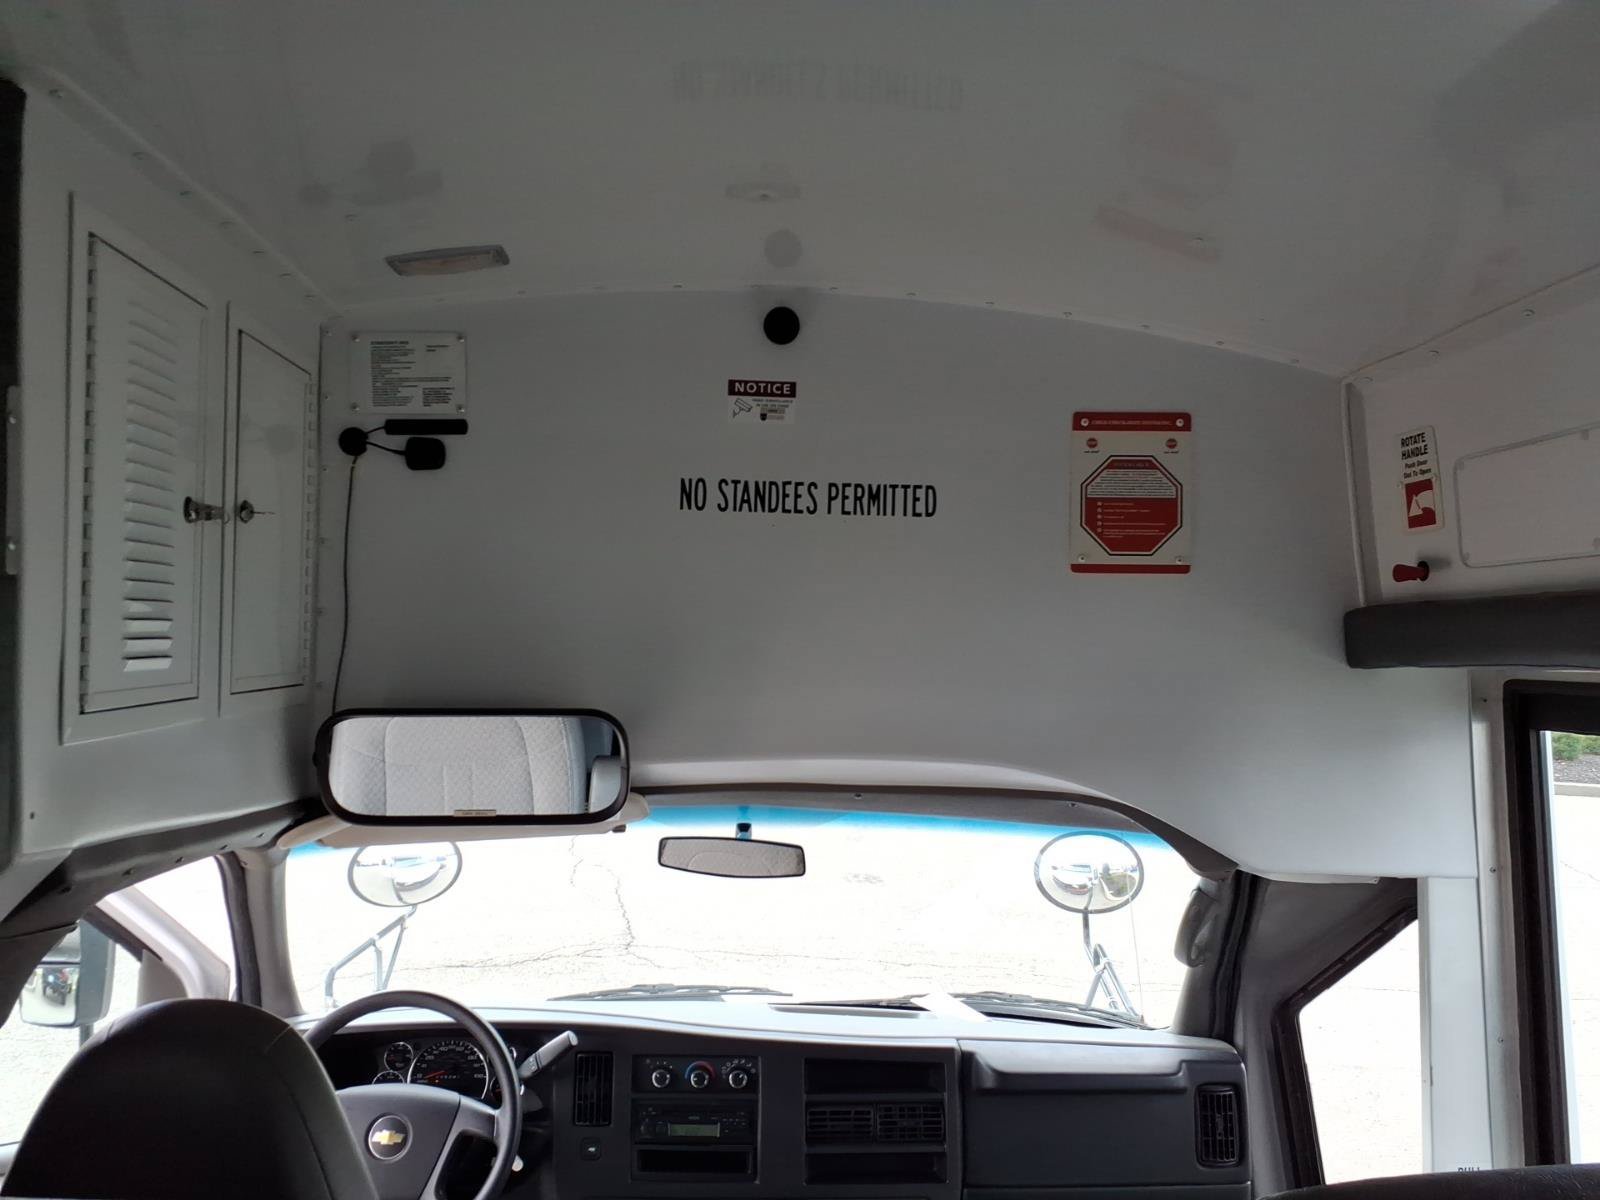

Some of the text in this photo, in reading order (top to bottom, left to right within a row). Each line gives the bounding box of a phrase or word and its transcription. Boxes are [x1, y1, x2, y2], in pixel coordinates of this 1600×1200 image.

[734, 382, 791, 394] NOTICE
[1401, 432, 1426, 447] ROTATE
[1401, 443, 1428, 460] HANDLE
[679, 477, 937, 517] NO STANDEES PERMITTED
